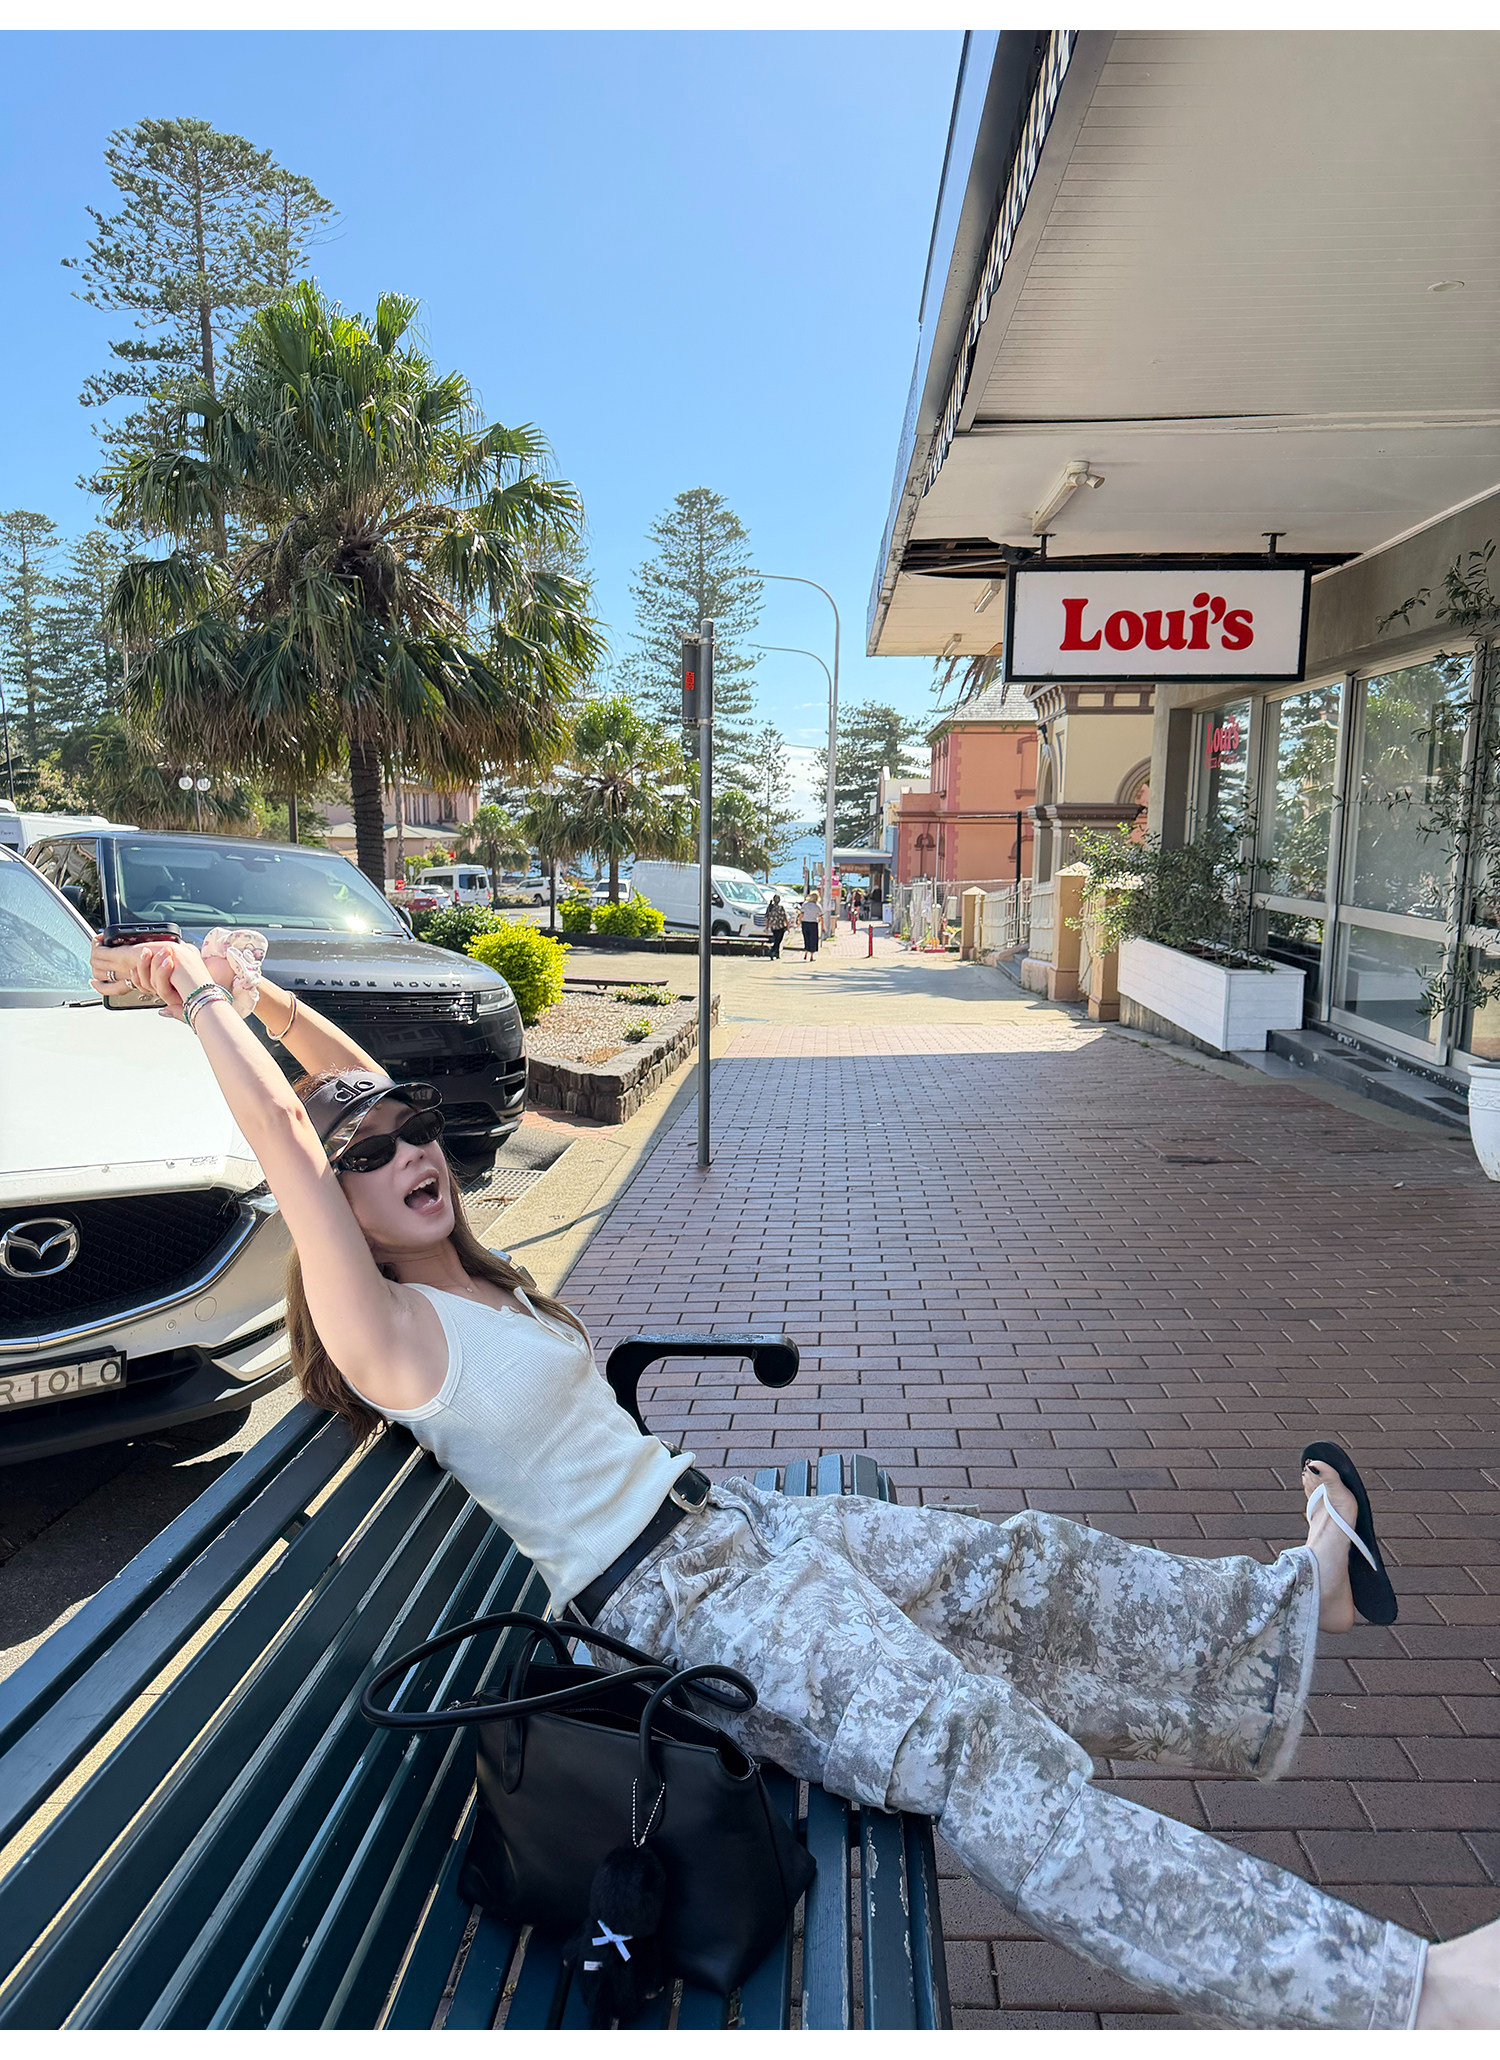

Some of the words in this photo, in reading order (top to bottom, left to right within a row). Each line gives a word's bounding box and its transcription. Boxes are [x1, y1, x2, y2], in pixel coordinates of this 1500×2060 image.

[1059, 592, 1254, 651] Loui's
[294, 978, 377, 988] RANGE
[393, 980, 462, 988] ROVER
[333, 1079, 375, 1102] alo
